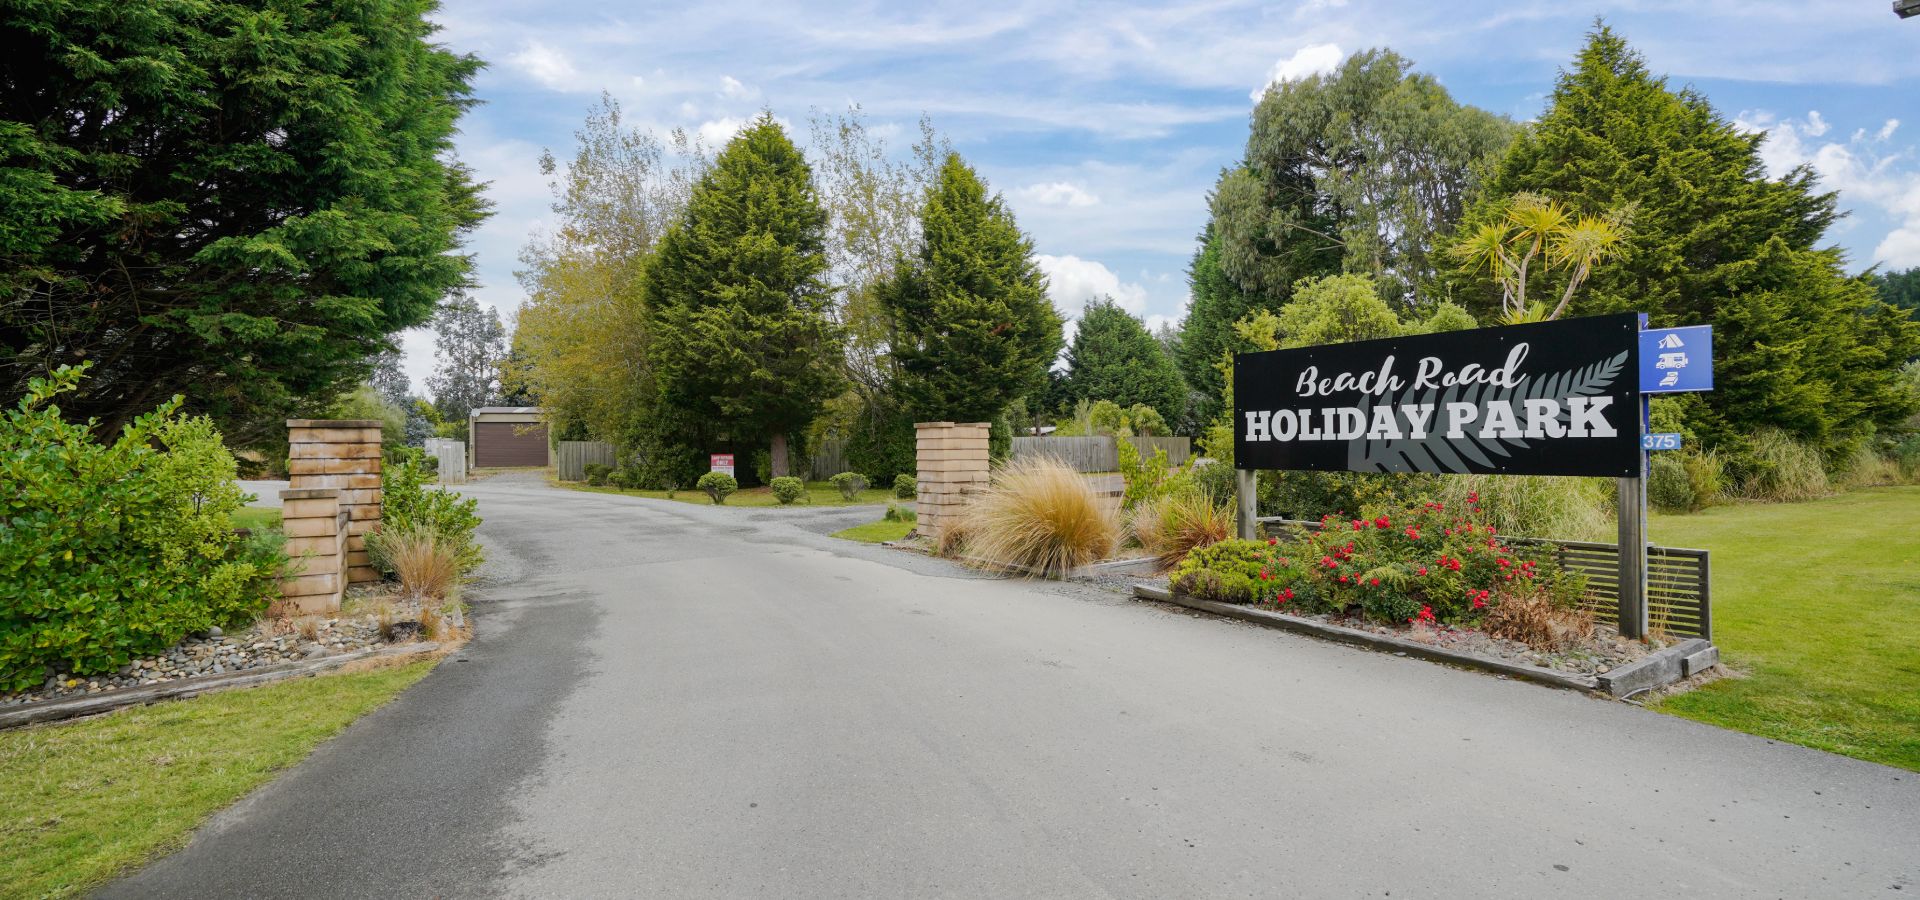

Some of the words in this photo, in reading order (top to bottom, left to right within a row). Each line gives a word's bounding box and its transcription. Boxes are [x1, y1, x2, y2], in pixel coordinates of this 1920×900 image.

[1295, 354, 1406, 398] Beach
[1414, 342, 1530, 391] Road
[1245, 403, 1435, 442] HOLIDAY
[1446, 396, 1618, 439] PARK
[1643, 435, 1675, 448] 375
